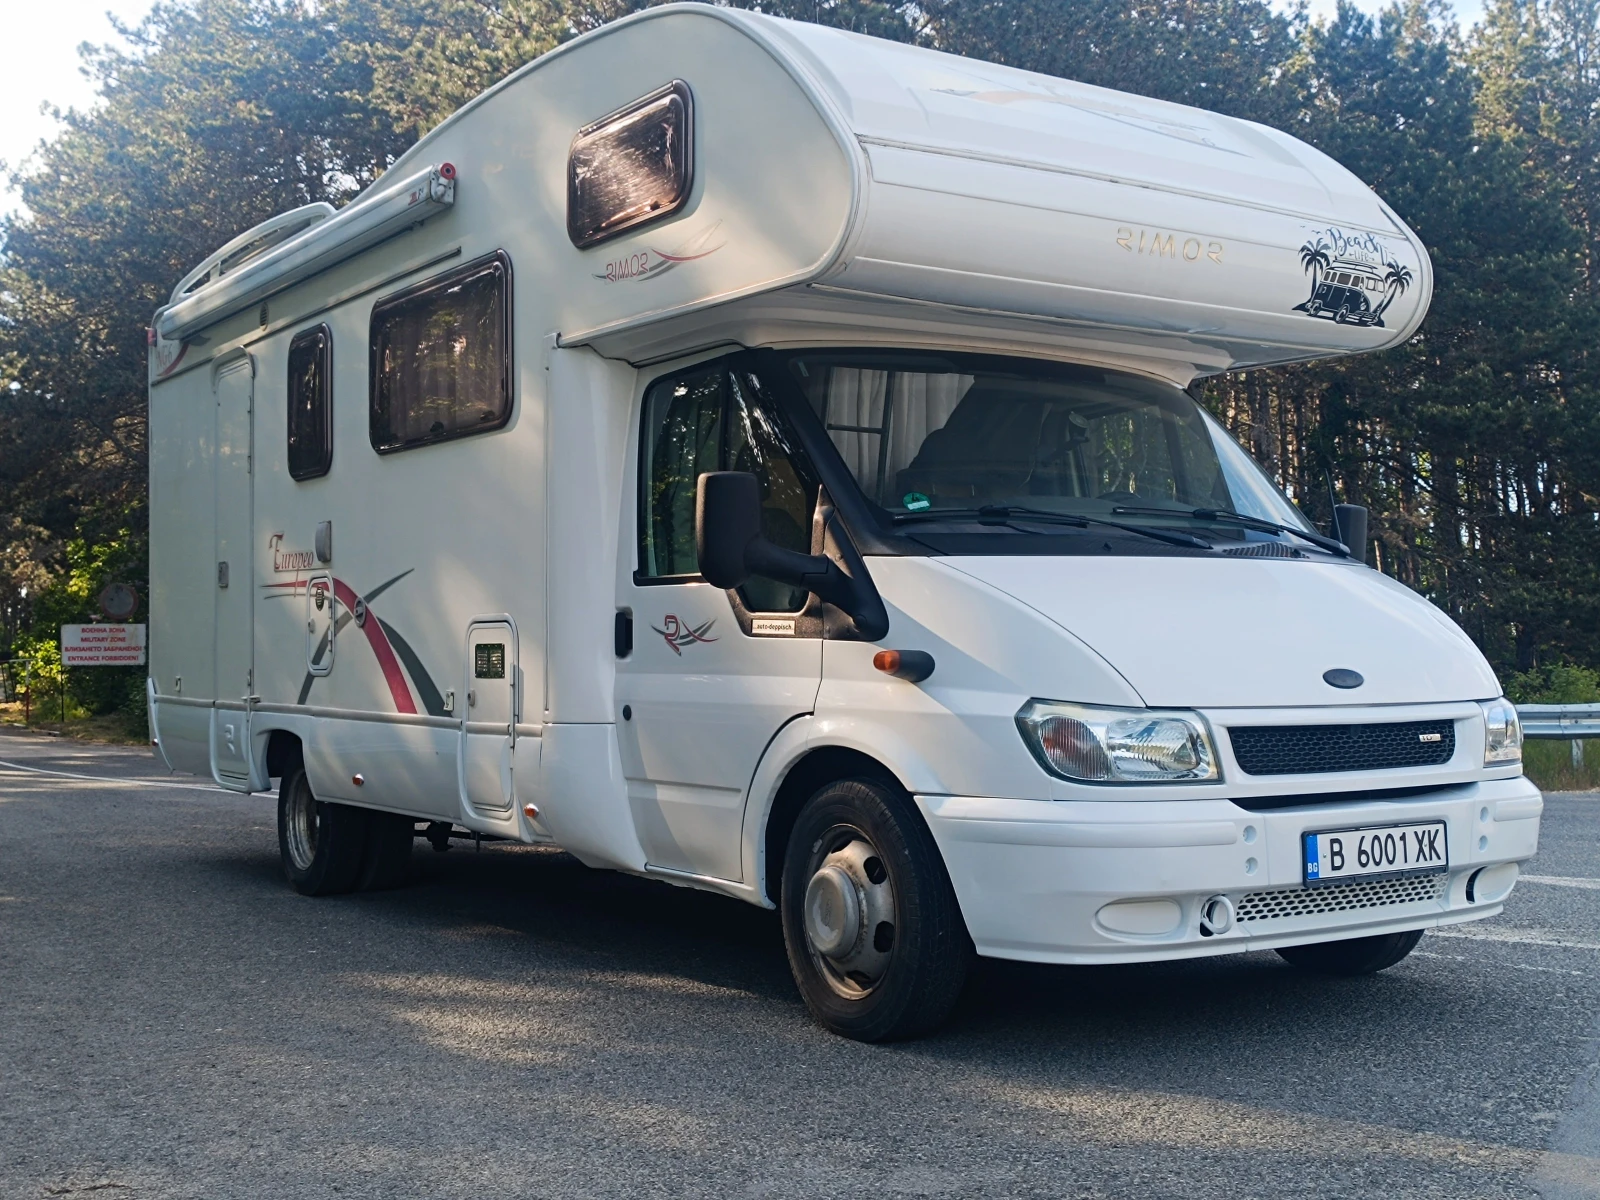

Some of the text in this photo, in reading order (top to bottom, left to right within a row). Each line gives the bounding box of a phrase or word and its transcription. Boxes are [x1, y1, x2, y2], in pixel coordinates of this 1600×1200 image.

[1116, 226, 1224, 265] RIMOR
[1325, 227, 1387, 266] Beach
[606, 252, 649, 282] RIMOR
[269, 533, 314, 597] Europeo
[1307, 862, 1318, 872] BG
[1330, 829, 1442, 871] B 6001 XK
